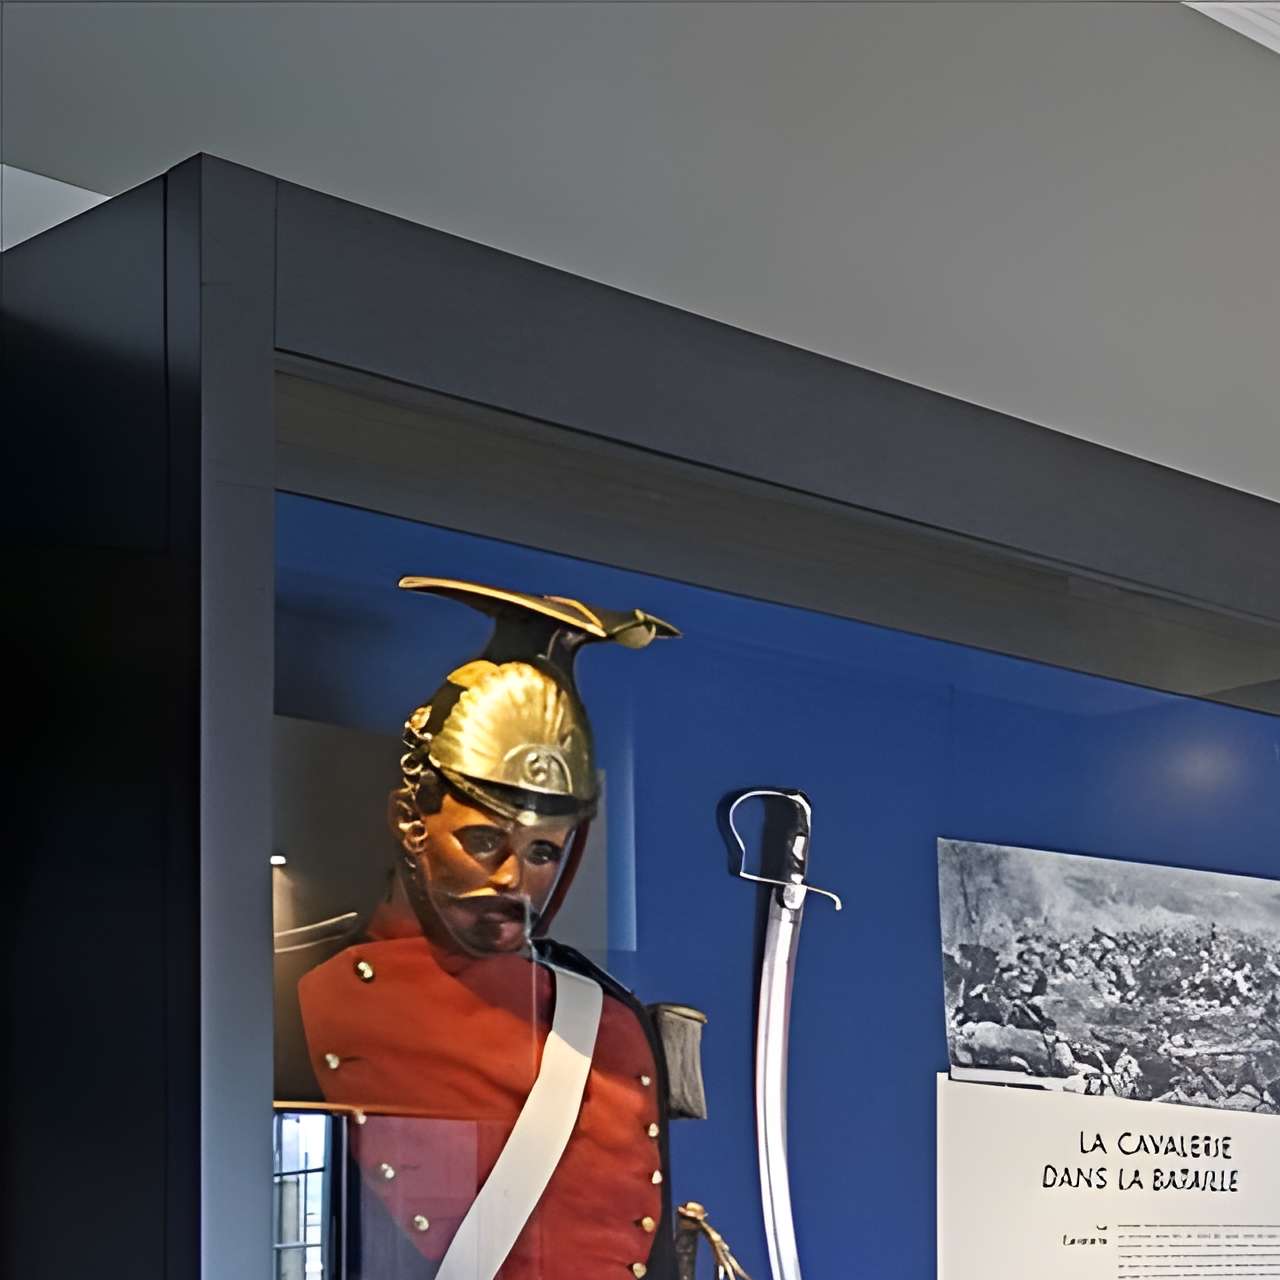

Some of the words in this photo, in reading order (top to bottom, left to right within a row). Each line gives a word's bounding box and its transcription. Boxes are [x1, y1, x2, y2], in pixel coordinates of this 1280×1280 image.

[1080, 1131, 1107, 1154] LA
[1042, 1164, 1107, 1189] DANS
[1118, 1168, 1144, 1191] LA
